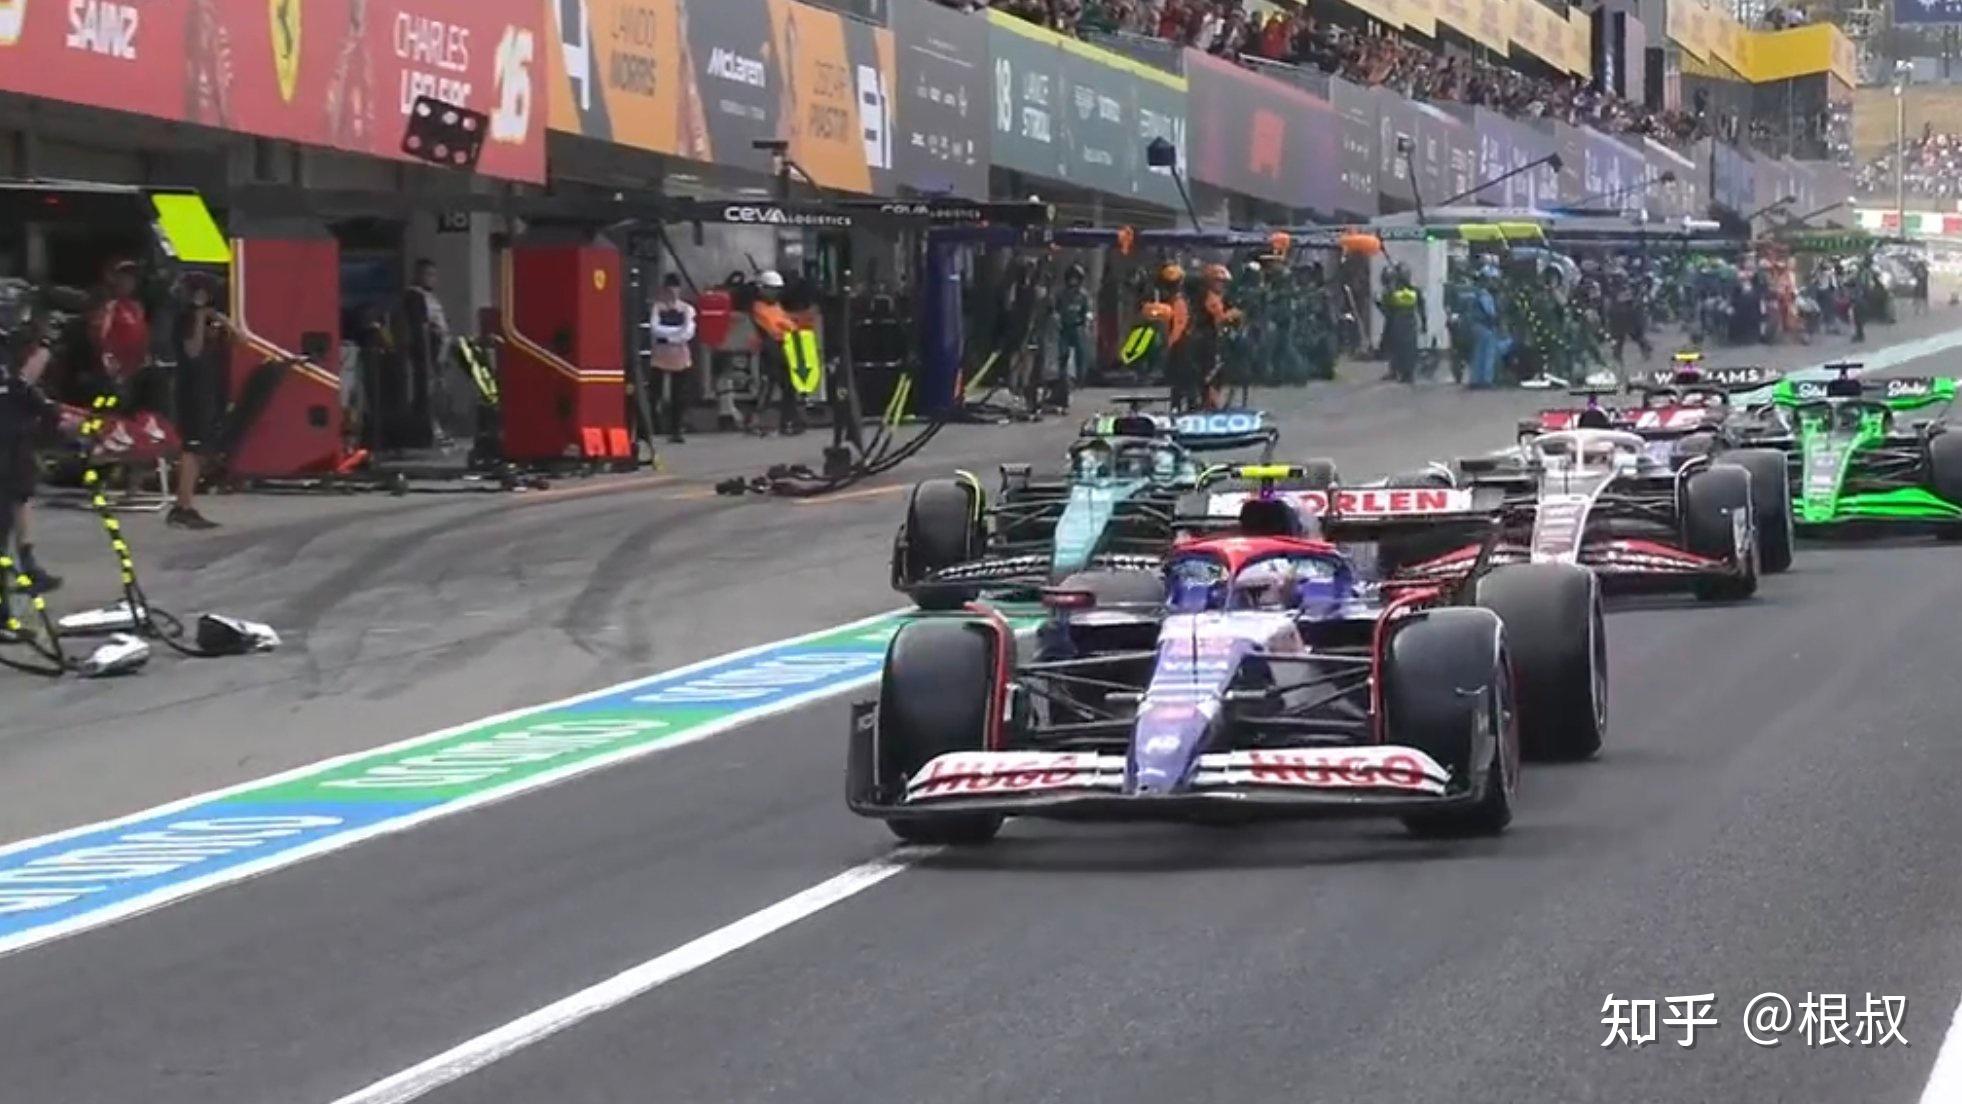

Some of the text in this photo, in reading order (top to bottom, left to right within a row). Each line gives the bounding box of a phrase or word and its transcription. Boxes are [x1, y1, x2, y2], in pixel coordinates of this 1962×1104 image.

[65, 0, 139, 59] SAINZ
[394, 12, 470, 72] CHARLES
[490, 24, 533, 145] 16
[707, 46, 766, 88] McLaren
[787, 212, 852, 226] LOGISTICS
[925, 755, 1078, 793] HUGO
[1249, 753, 1425, 786] HUGO
